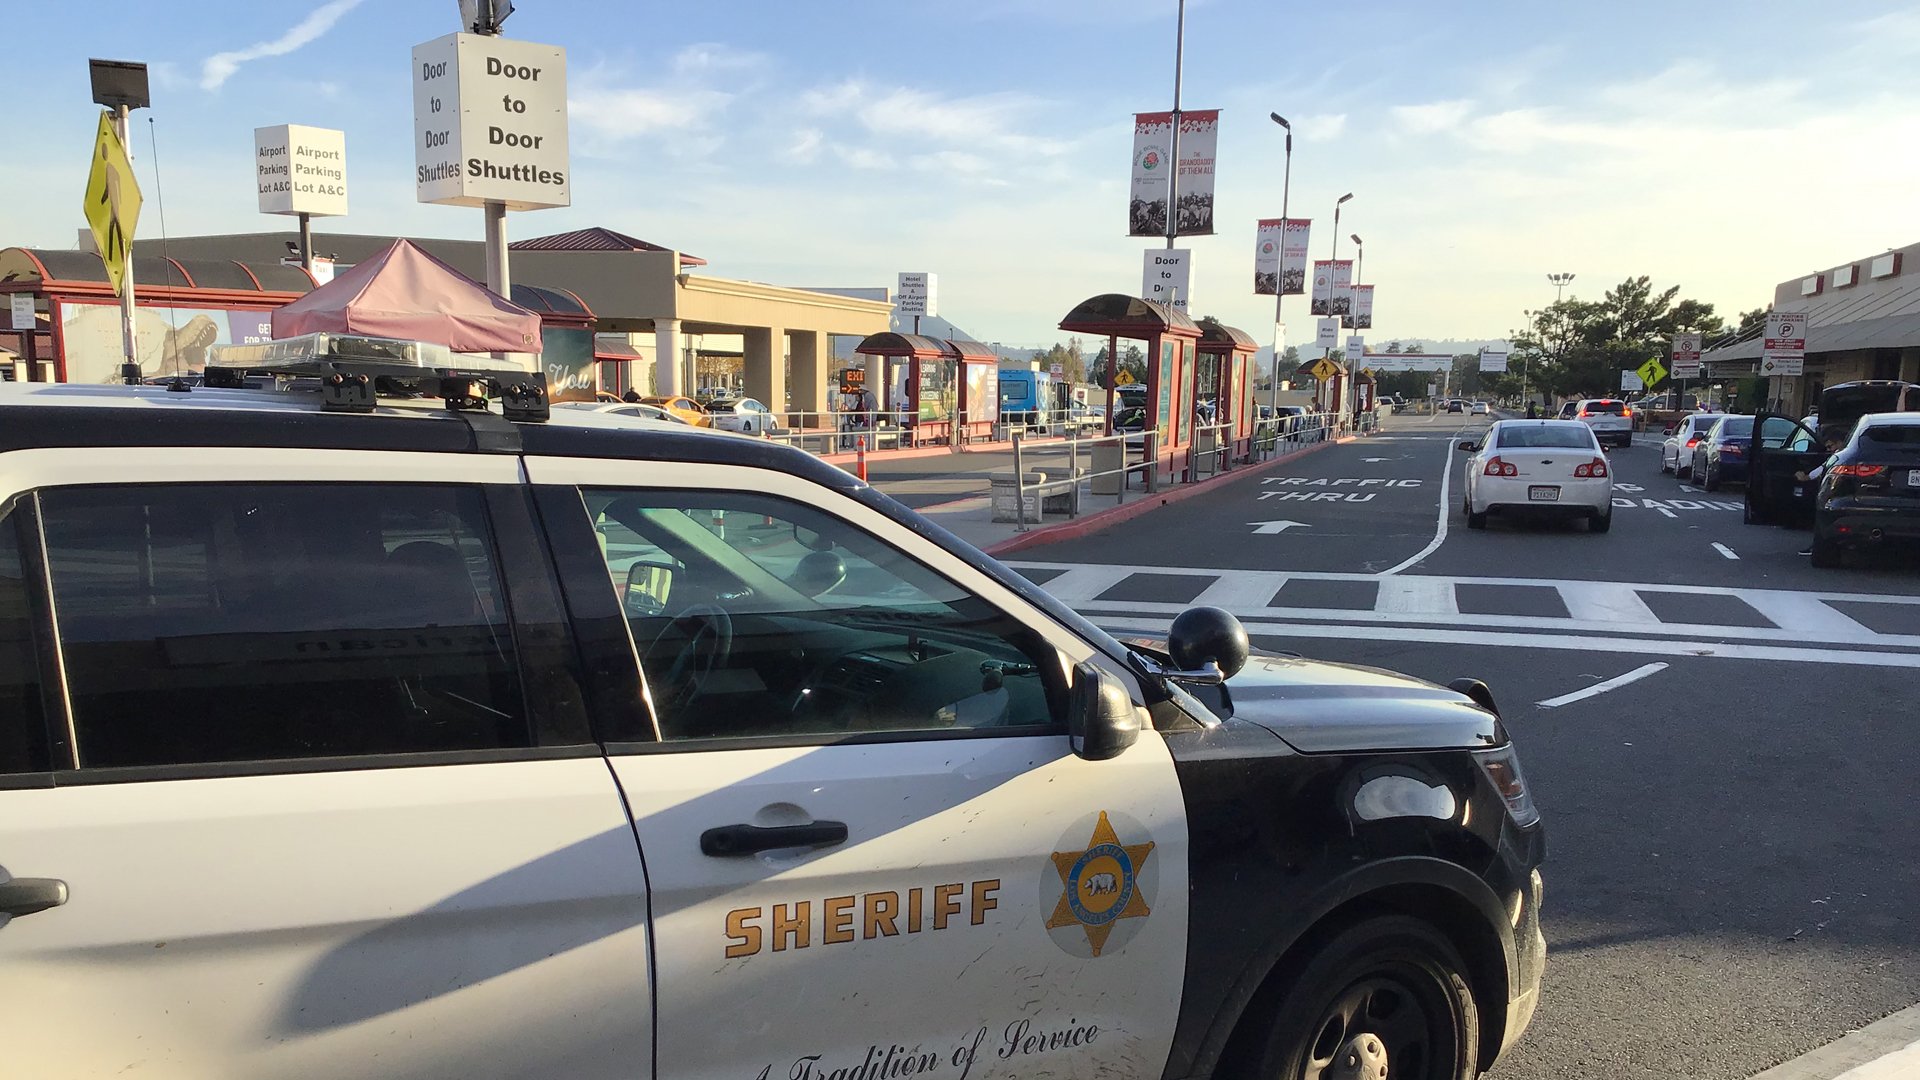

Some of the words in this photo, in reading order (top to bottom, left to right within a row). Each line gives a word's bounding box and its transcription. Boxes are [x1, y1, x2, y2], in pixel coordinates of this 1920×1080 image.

[423, 61, 447, 81] Door
[486, 56, 541, 81] Door
[431, 96, 441, 113] to
[503, 94, 526, 114] to
[426, 130, 449, 148] Door
[489, 126, 543, 150] Door
[259, 145, 286, 158] Airport
[296, 146, 339, 160] Airport
[259, 164, 288, 175] Parking
[295, 163, 341, 180] Parking
[418, 161, 460, 183] Shuttles
[468, 158, 564, 185] Shuttles
[259, 183, 271, 193] Lot
[273, 181, 290, 192] A&C
[294, 181, 314, 193] Lot
[318, 184, 344, 196] A&C
[1155, 256, 1180, 265] Door
[1161, 270, 1171, 278] to
[549, 363, 591, 397] You
[1260, 477, 1423, 487] TRAFFIC
[1257, 491, 1377, 502] THRU
[725, 878, 1001, 959] SHERIFF
[789, 1044, 937, 1080] Tradition
[952, 1026, 987, 1080] of
[998, 1018, 1098, 1059] Service
